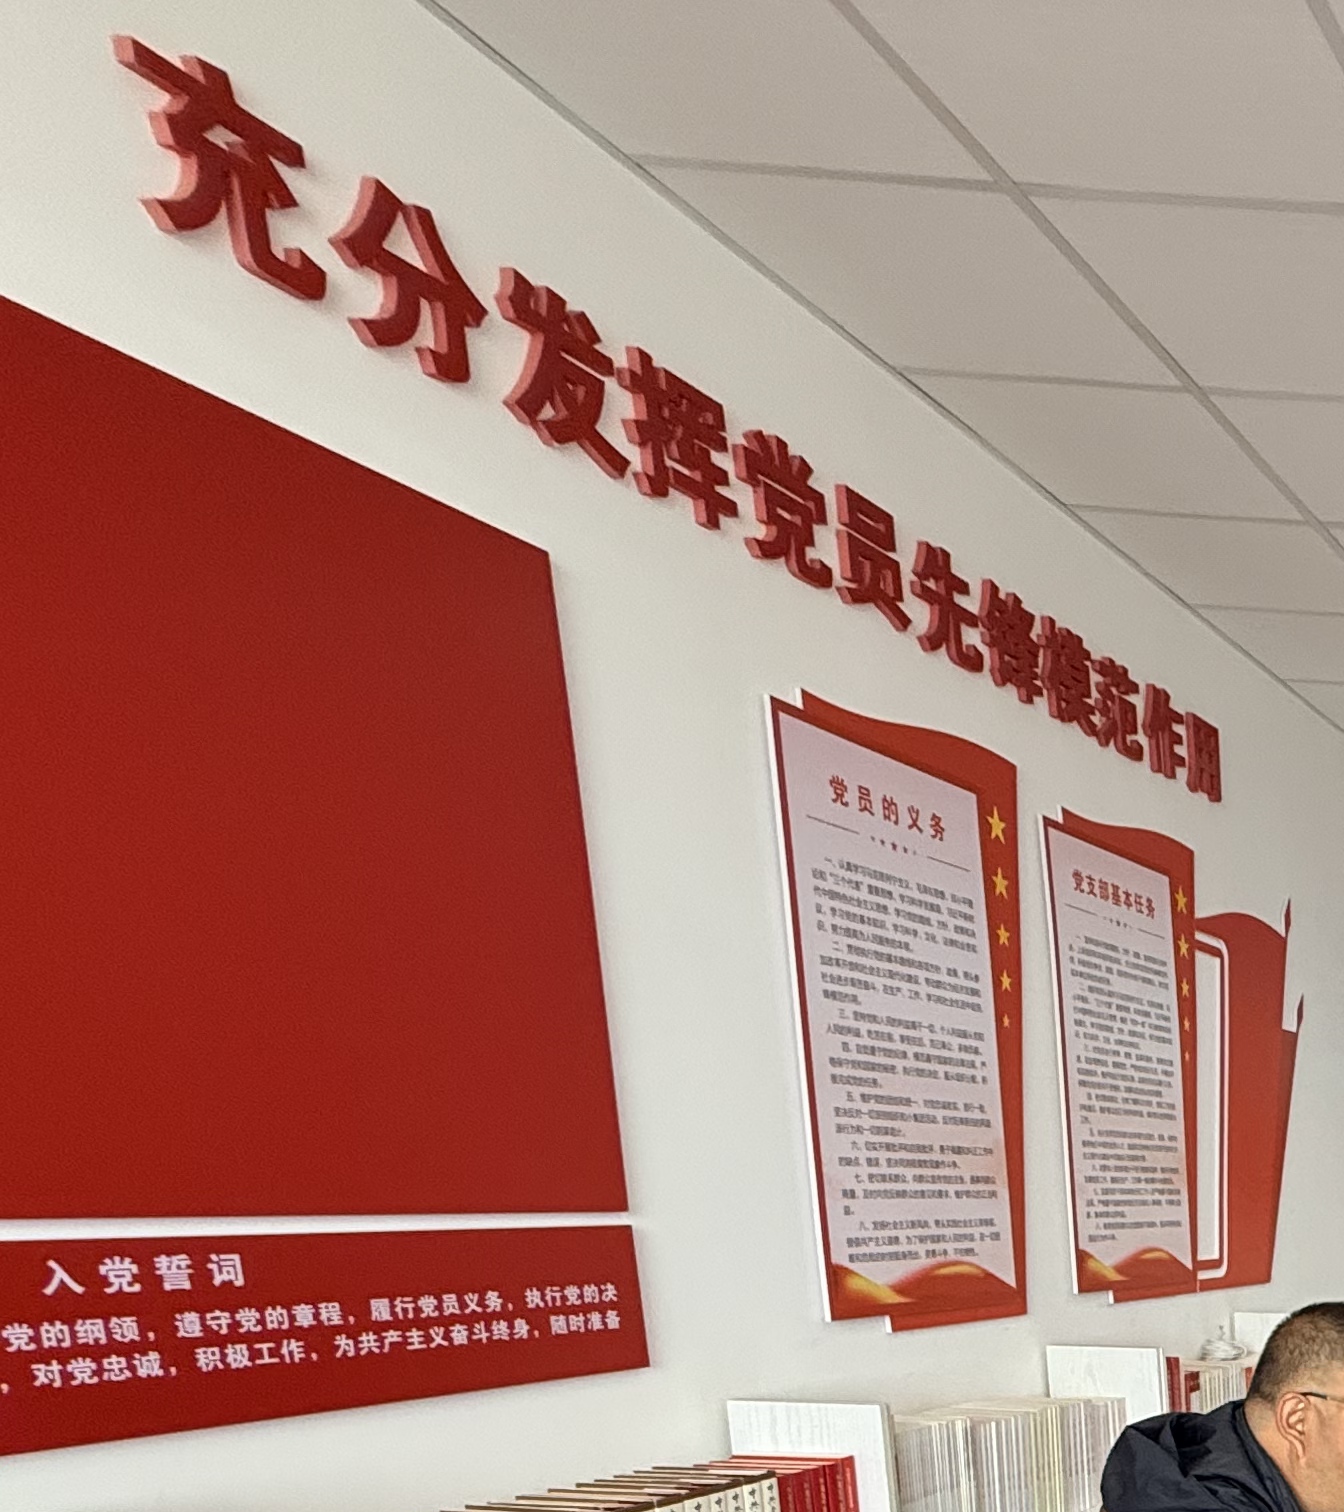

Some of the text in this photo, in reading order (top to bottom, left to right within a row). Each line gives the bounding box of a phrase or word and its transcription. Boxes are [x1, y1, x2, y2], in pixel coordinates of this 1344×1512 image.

[112, 34, 1224, 803] 充分发挥党员先锋模范作用
[829, 775, 946, 842] 党员的义务
[1072, 868, 1156, 919] 党支部基本任务
[42, 1252, 245, 1296] 入党誓词
